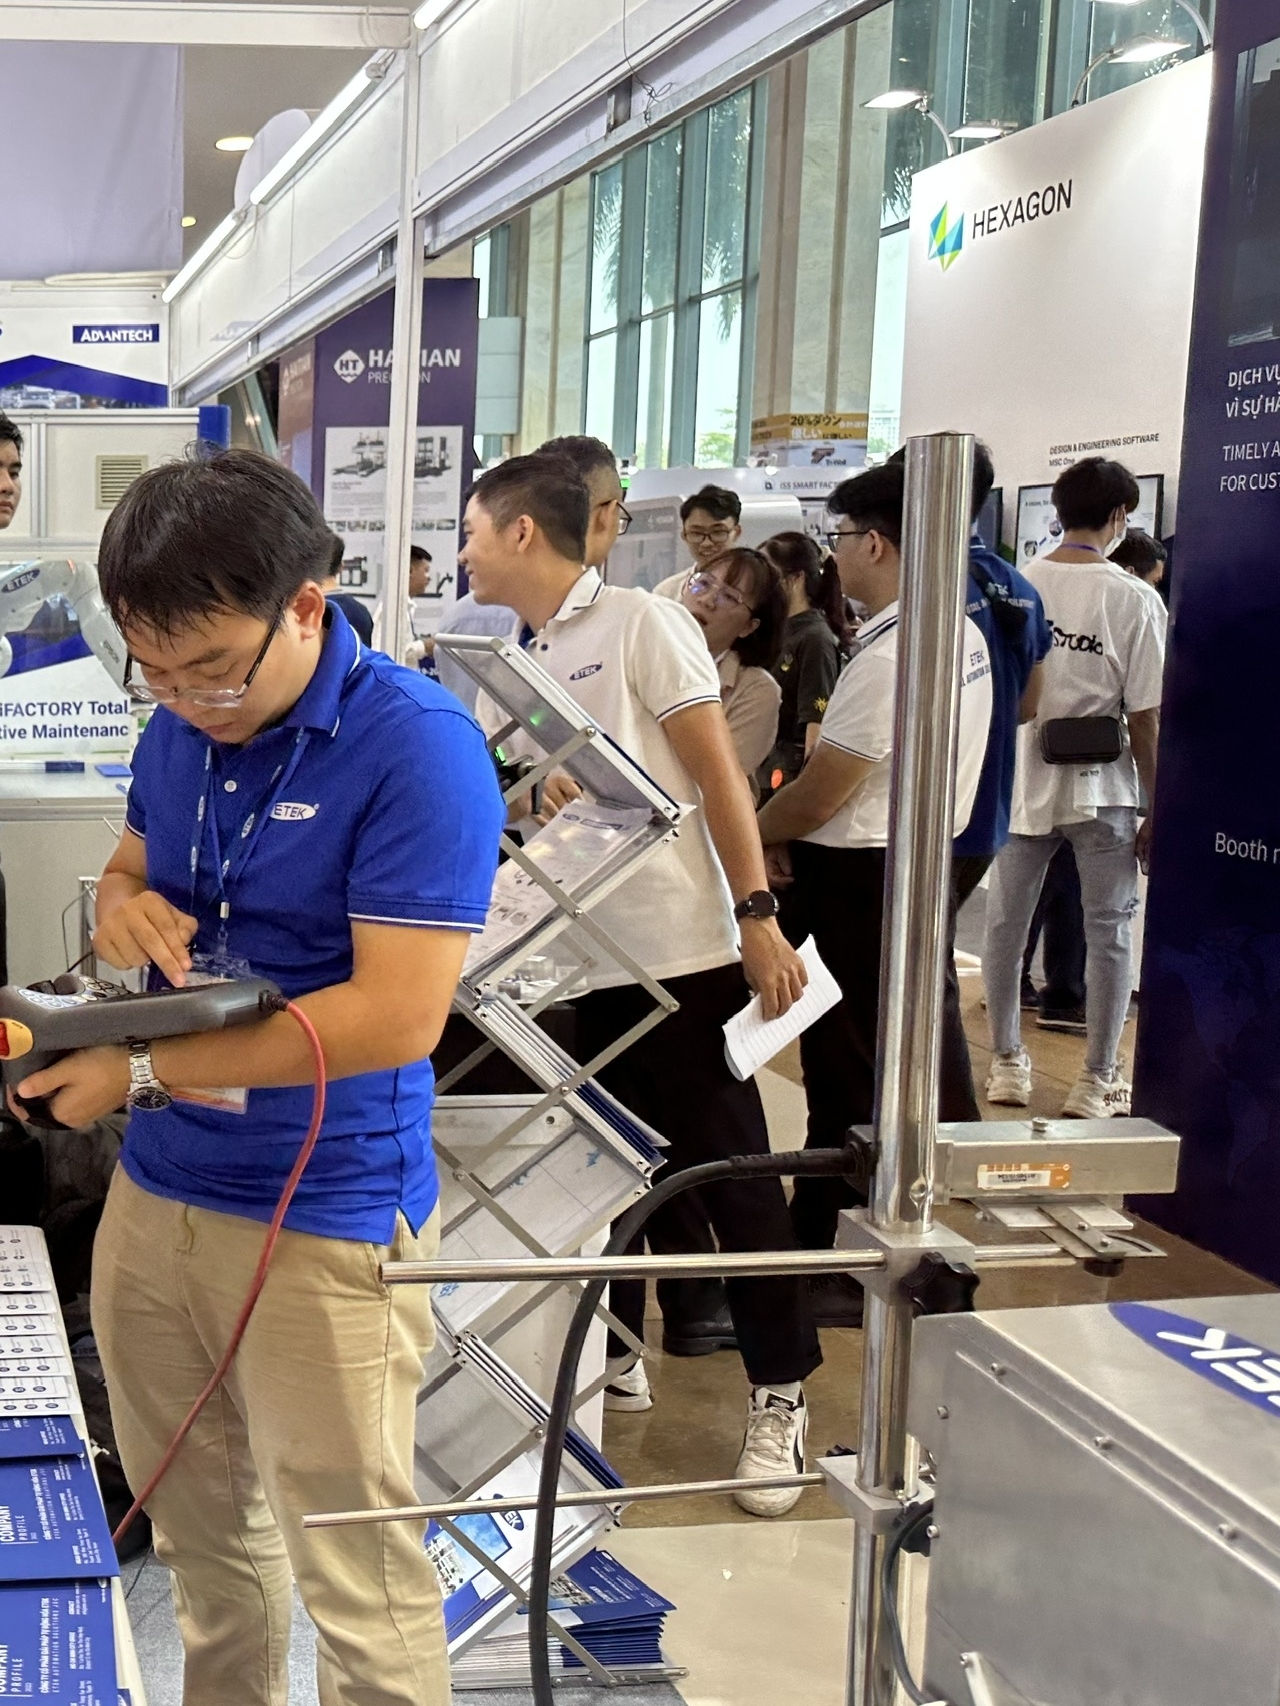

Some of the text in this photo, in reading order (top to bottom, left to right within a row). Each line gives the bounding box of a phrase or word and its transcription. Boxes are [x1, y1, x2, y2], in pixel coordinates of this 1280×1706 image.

[972, 179, 1072, 240] HEXAGON
[81, 328, 153, 342] ADVANTECH
[369, 349, 461, 368] HAIAN
[1228, 367, 1262, 391] DỊCH
[1226, 397, 1239, 418] VÌ
[1242, 394, 1264, 419] SỰ
[1049, 444, 1073, 455] DESIGN
[1078, 438, 1122, 452] ENGINEERING
[1122, 433, 1160, 446] SOFTWARE
[1223, 442, 1270, 461] TIMELY
[793, 482, 818, 490] SMART
[1220, 474, 1247, 492] FOR
[6, 571, 36, 591] ETEK
[0, 699, 129, 717] iFACTORY Total
[32, 724, 129, 739] Maintenanc
[274, 804, 307, 819] ETEK
[1215, 832, 1268, 862] Booth
[1156, 1328, 1280, 1408] EK
[14, 1515, 28, 1541] PROFILE
[10, 1658, 23, 1693] PROFILE
